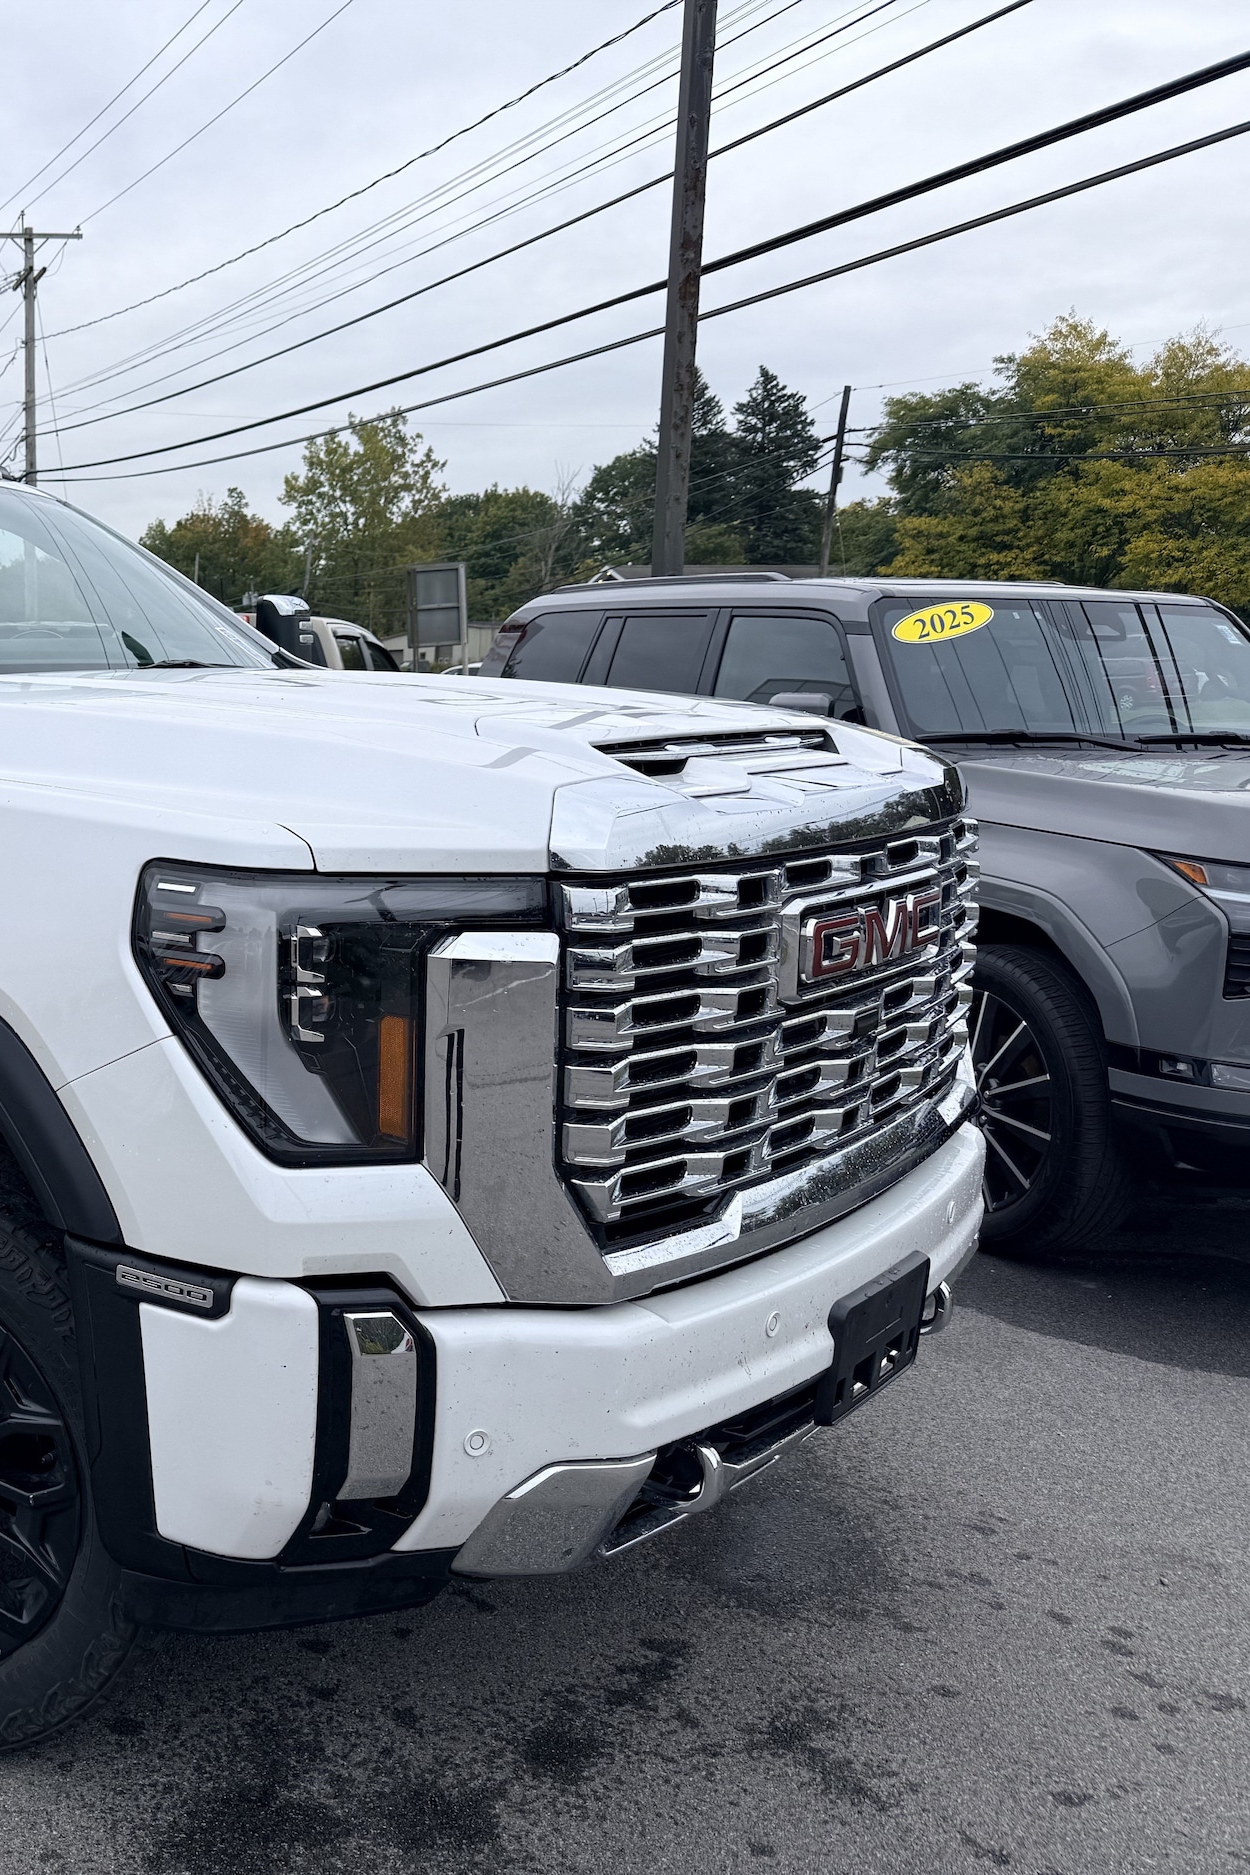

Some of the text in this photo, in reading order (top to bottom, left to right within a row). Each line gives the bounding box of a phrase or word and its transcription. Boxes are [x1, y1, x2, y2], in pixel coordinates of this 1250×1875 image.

[913, 605, 975, 639] 2025
[805, 886, 941, 983] GMC
[121, 1272, 207, 1301] 2500
